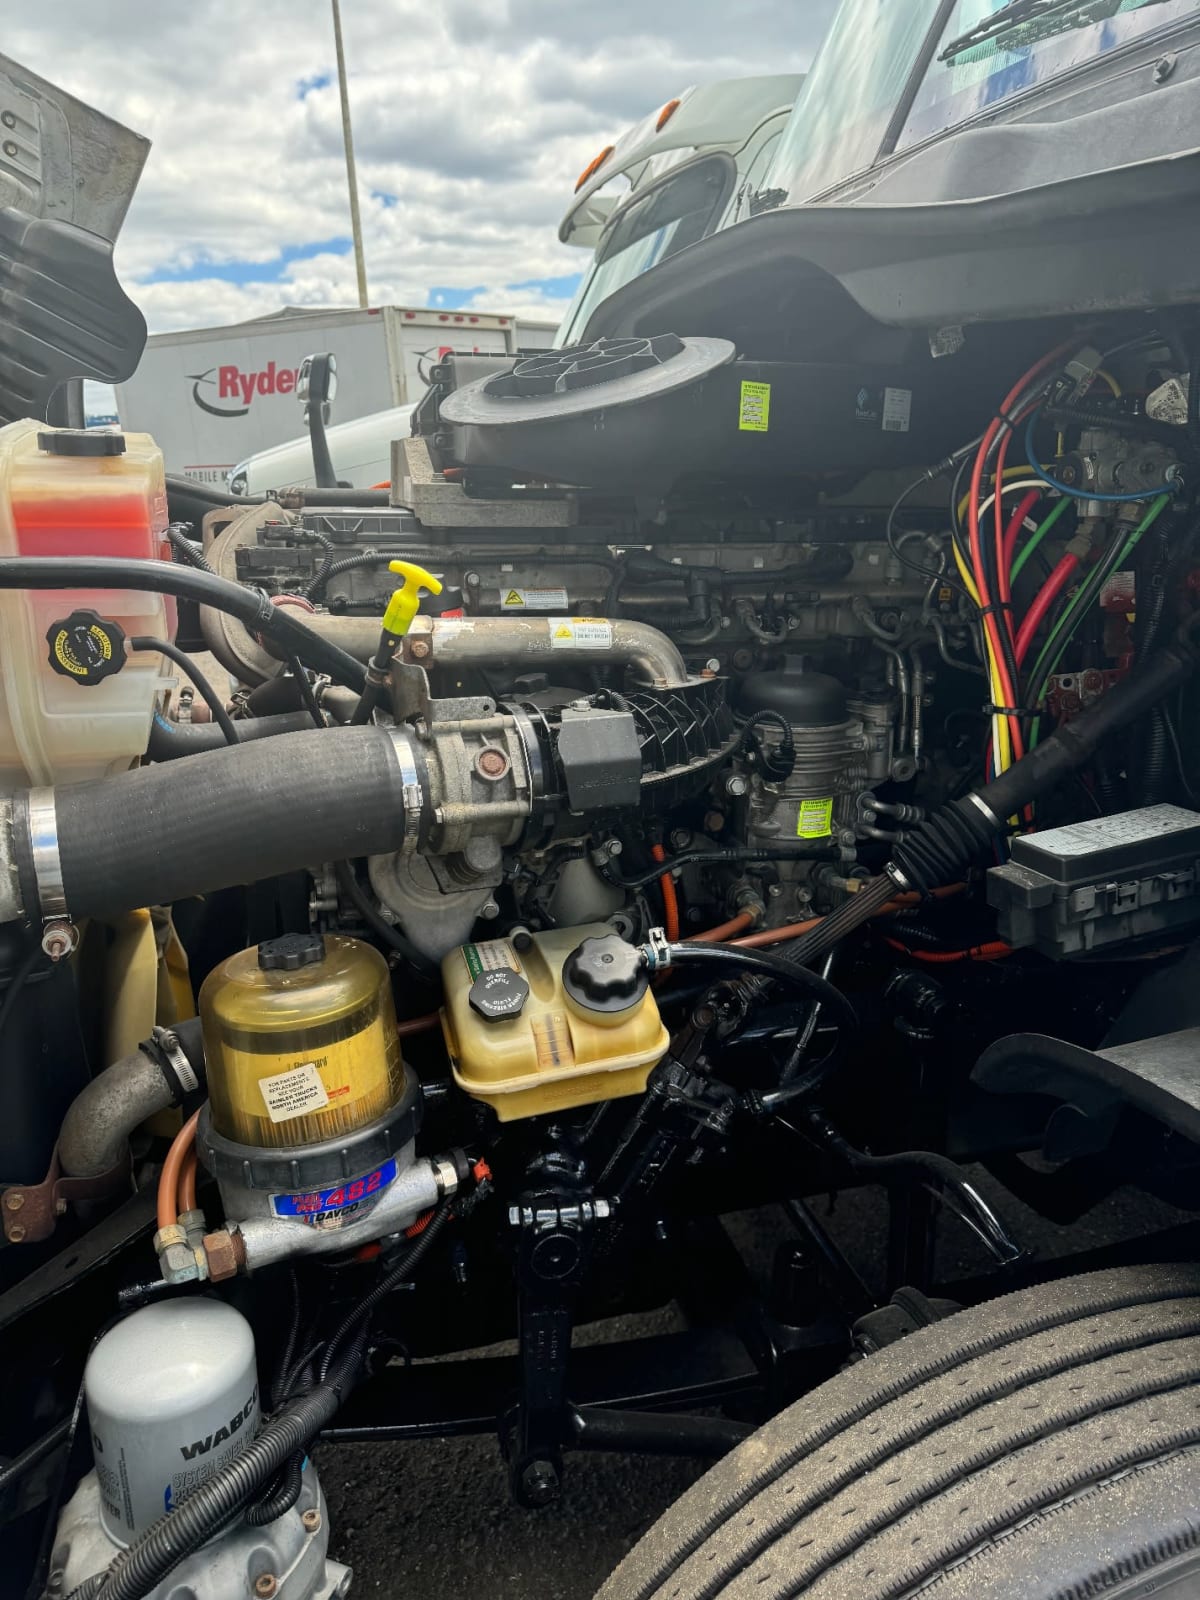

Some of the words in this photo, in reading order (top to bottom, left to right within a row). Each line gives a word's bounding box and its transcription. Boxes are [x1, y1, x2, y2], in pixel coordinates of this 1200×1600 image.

[485, 978, 510, 989] OVERFILL
[325, 1171, 382, 1207] 482
[315, 1202, 359, 1221] DAVCO
[179, 1383, 258, 1461] WABCO
[173, 1459, 216, 1488] SYSTEM
